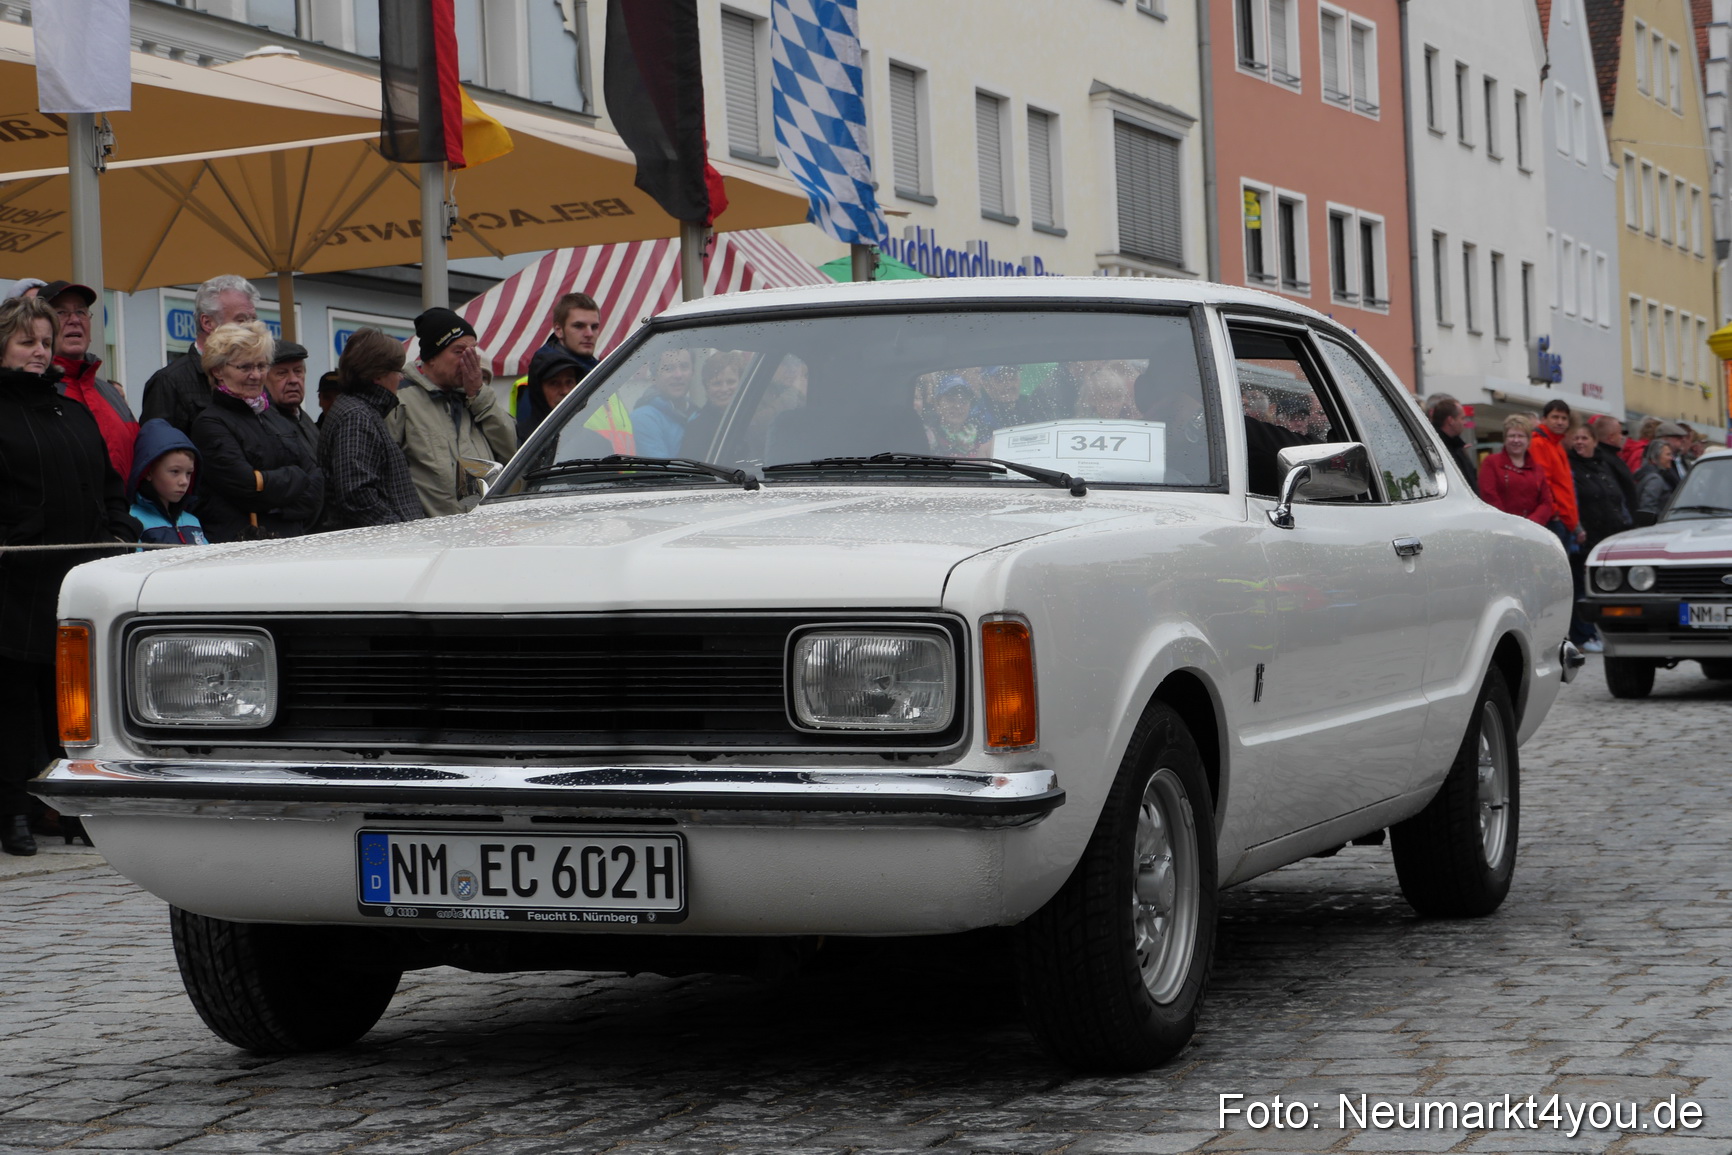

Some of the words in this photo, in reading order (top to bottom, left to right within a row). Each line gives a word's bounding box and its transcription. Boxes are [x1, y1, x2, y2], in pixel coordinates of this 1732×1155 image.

[1070, 435, 1127, 452] 347
[1689, 606, 1713, 622] NM
[371, 875, 382, 890] D
[391, 842, 448, 895] NM
[480, 843, 538, 898] EC
[551, 844, 674, 899] 602H
[527, 911, 567, 921] Feucht
[569, 912, 580, 921] b.
[583, 912, 638, 924] Nürnberg
